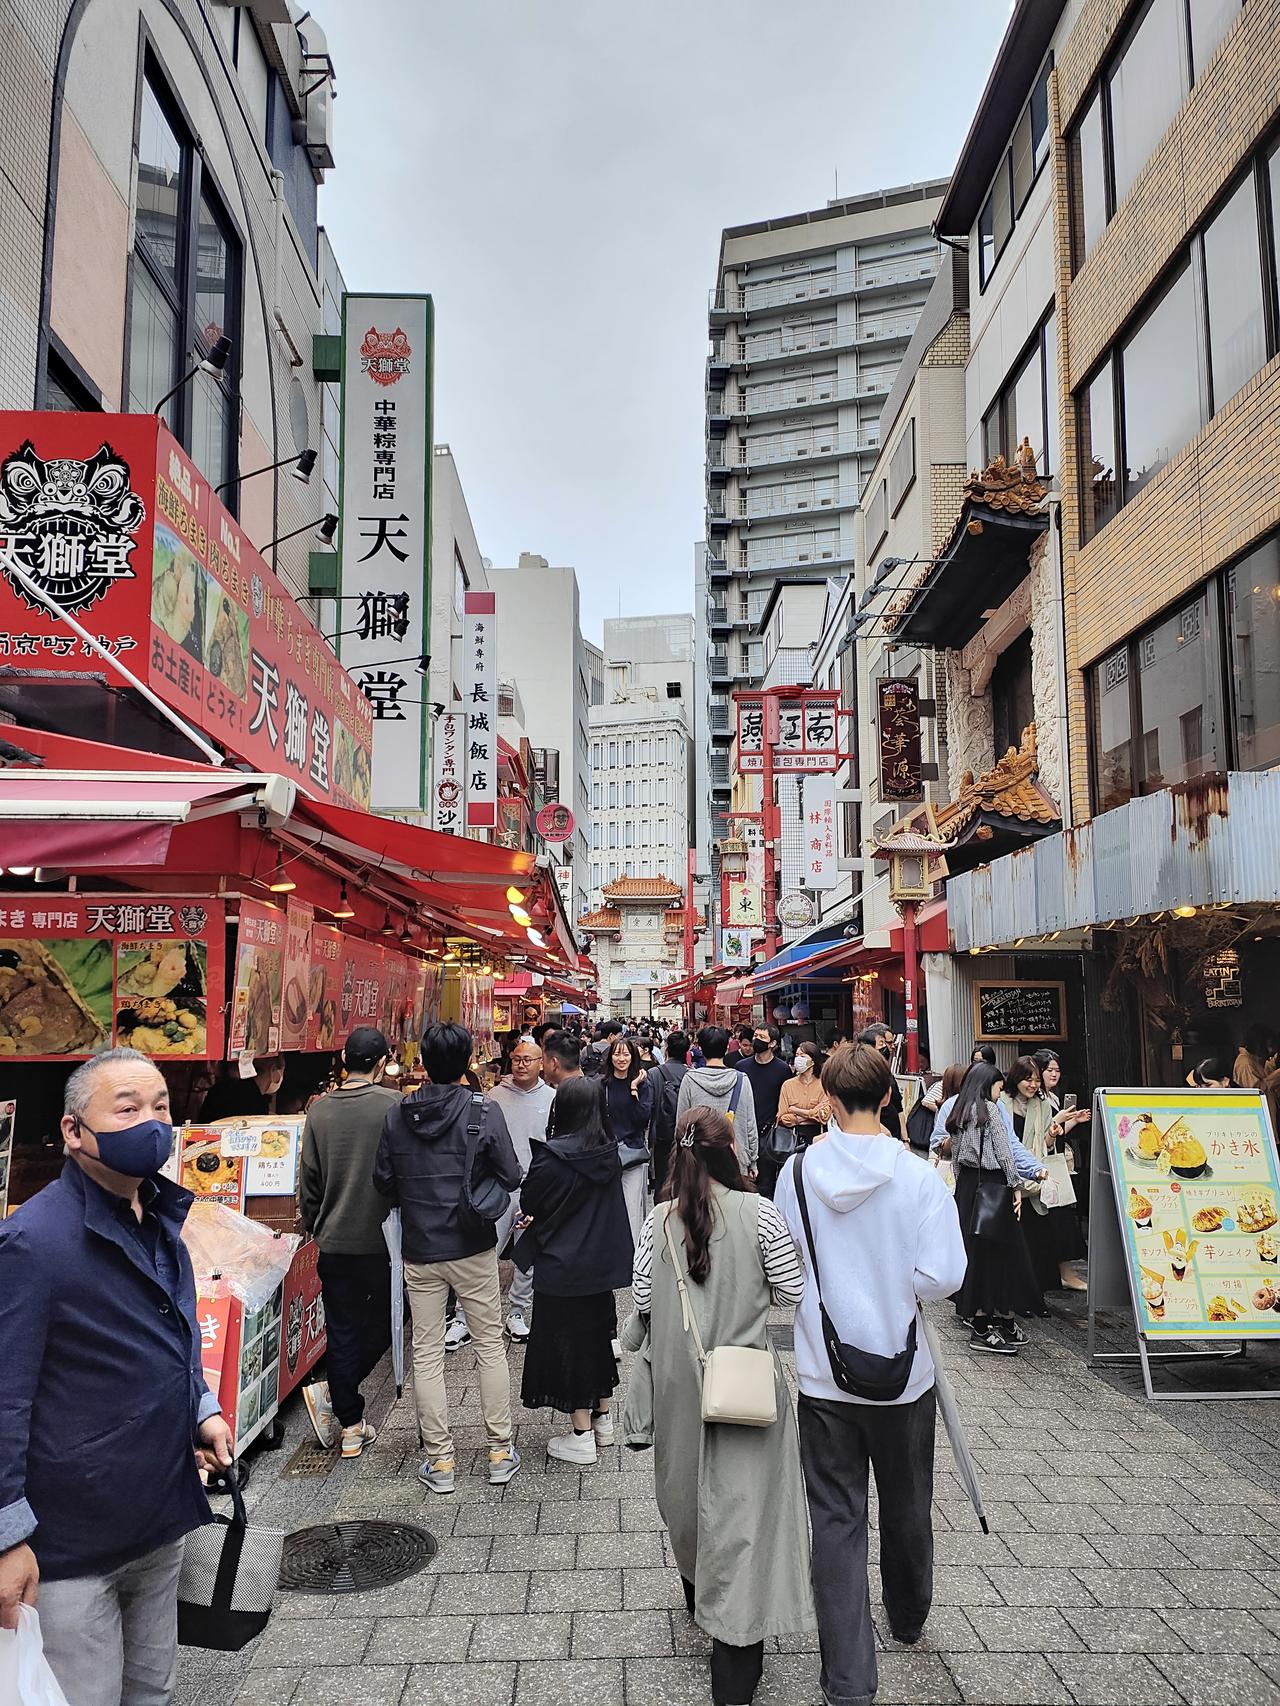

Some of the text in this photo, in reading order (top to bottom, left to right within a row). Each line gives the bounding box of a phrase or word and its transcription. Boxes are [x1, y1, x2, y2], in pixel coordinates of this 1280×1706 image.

[361, 357, 411, 374] 天獅堂
[373, 399, 397, 500] 中華粽専門店
[157, 473, 208, 559] 海鮮ちまき
[0, 531, 137, 578] 天獅堂
[209, 540, 250, 608] 肉ちまき
[356, 513, 411, 721] 天獅堂
[80, 634, 138, 659] 神戸
[249, 647, 332, 793] 天獅堂
[468, 683, 490, 792] 長城飯店
[809, 811, 823, 874] 林商店
[32, 912, 78, 929] 専門店
[86, 904, 176, 934] 天獅堂
[120, 942, 164, 951] 海鮮ちまき
[1211, 1139, 1261, 1158] かき氷
[1203, 1245, 1252, 1260] 芋シェイク
